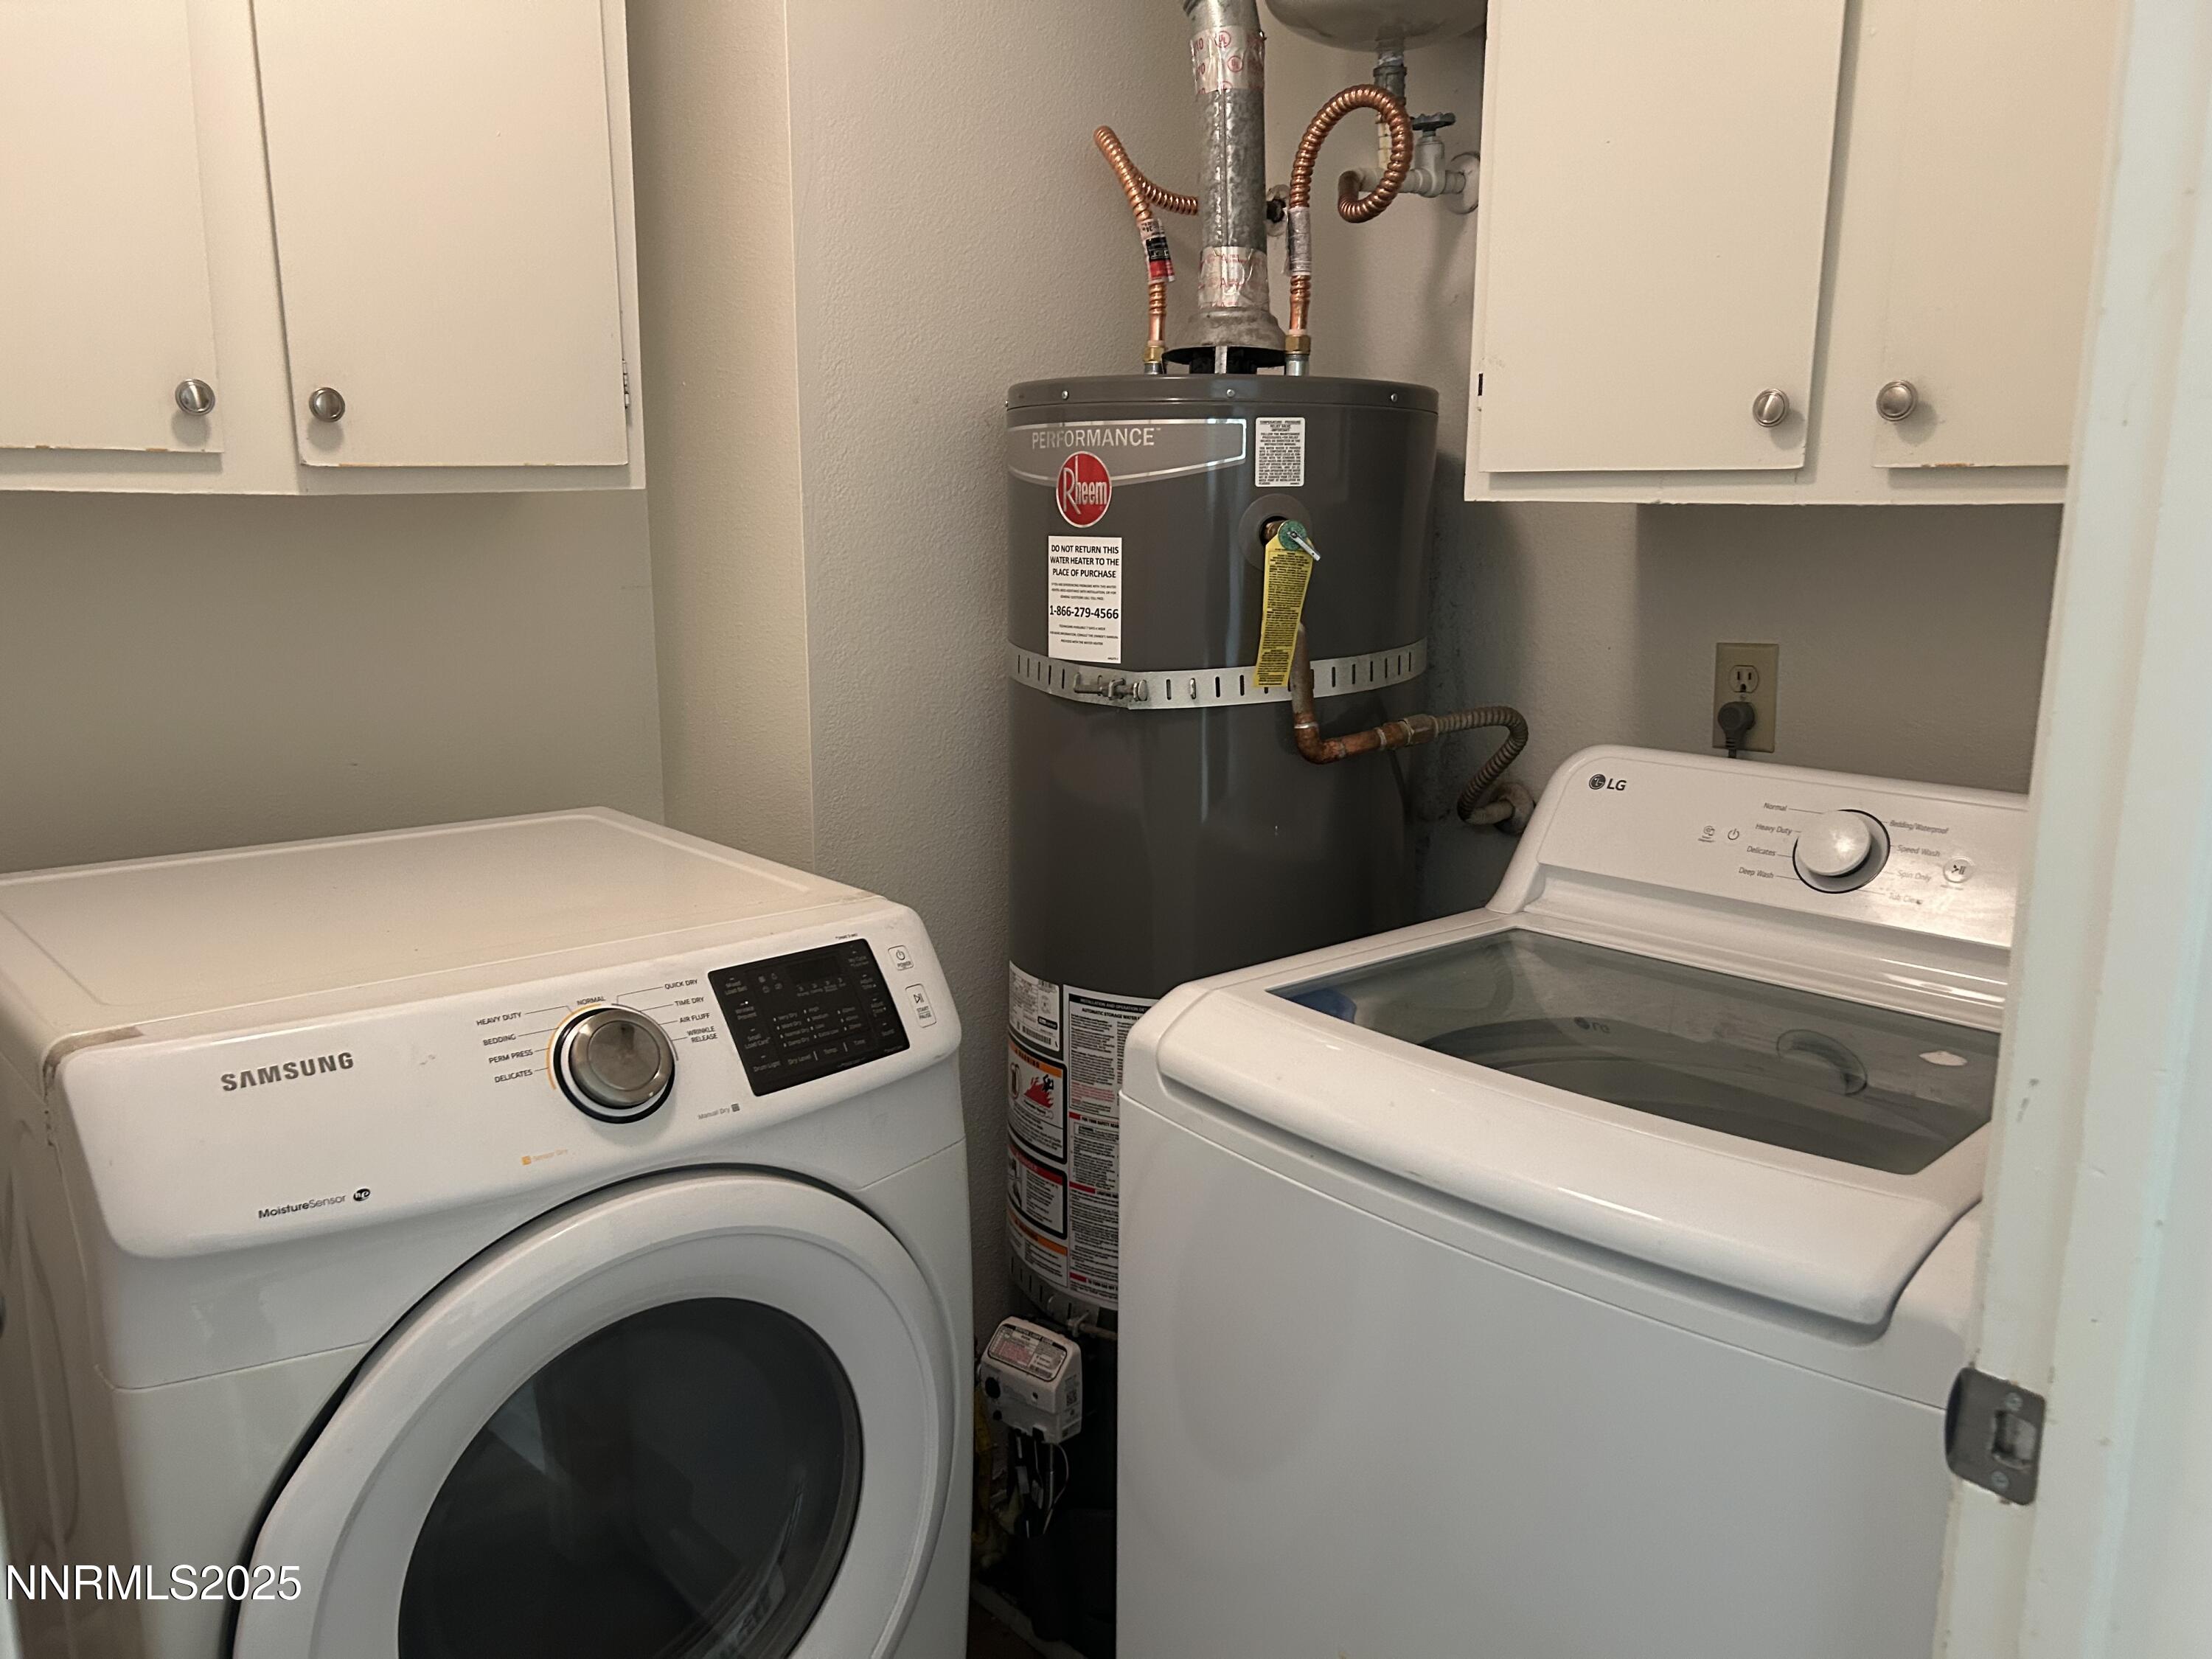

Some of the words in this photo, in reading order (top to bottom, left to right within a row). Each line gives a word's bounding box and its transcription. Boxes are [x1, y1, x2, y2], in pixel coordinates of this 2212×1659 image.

[1032, 428, 1155, 449] PERFORMANCE
[1062, 455, 1107, 515] Rheem
[1075, 546, 1101, 554] RETURN
[1096, 557, 1105, 566] TO
[1081, 569, 1116, 578] PURCHASE
[1050, 605, 1119, 619] 1-866-279-4566
[1607, 778, 1627, 791] LG
[1764, 802, 1787, 811] Normal
[1756, 824, 1775, 832] Heavy
[1776, 826, 1792, 835] Duty
[1746, 846, 1775, 856] Delicates
[1897, 845, 1920, 855] Speed
[1921, 848, 1941, 857] Wash
[1739, 866, 1756, 876] Deep
[1756, 870, 1774, 878] Wash
[1898, 870, 1913, 879] Spin
[1915, 872, 1932, 883] Only
[664, 981, 684, 990] QUICK
[577, 996, 606, 1006] NORMAL
[476, 1015, 501, 1026] HEAVY
[502, 1012, 521, 1021] DUTY
[692, 1012, 710, 1020] FLUFF
[687, 1026, 715, 1037] WRINKLE
[482, 1034, 516, 1046] BEDDING
[691, 1033, 718, 1043] RELEASE
[489, 1054, 510, 1064] PERM
[511, 1049, 534, 1059] PRESS
[220, 1051, 354, 1091] SAMSUNG
[495, 1069, 533, 1083] DELICATES
[258, 1194, 347, 1219] MoistureSensor
